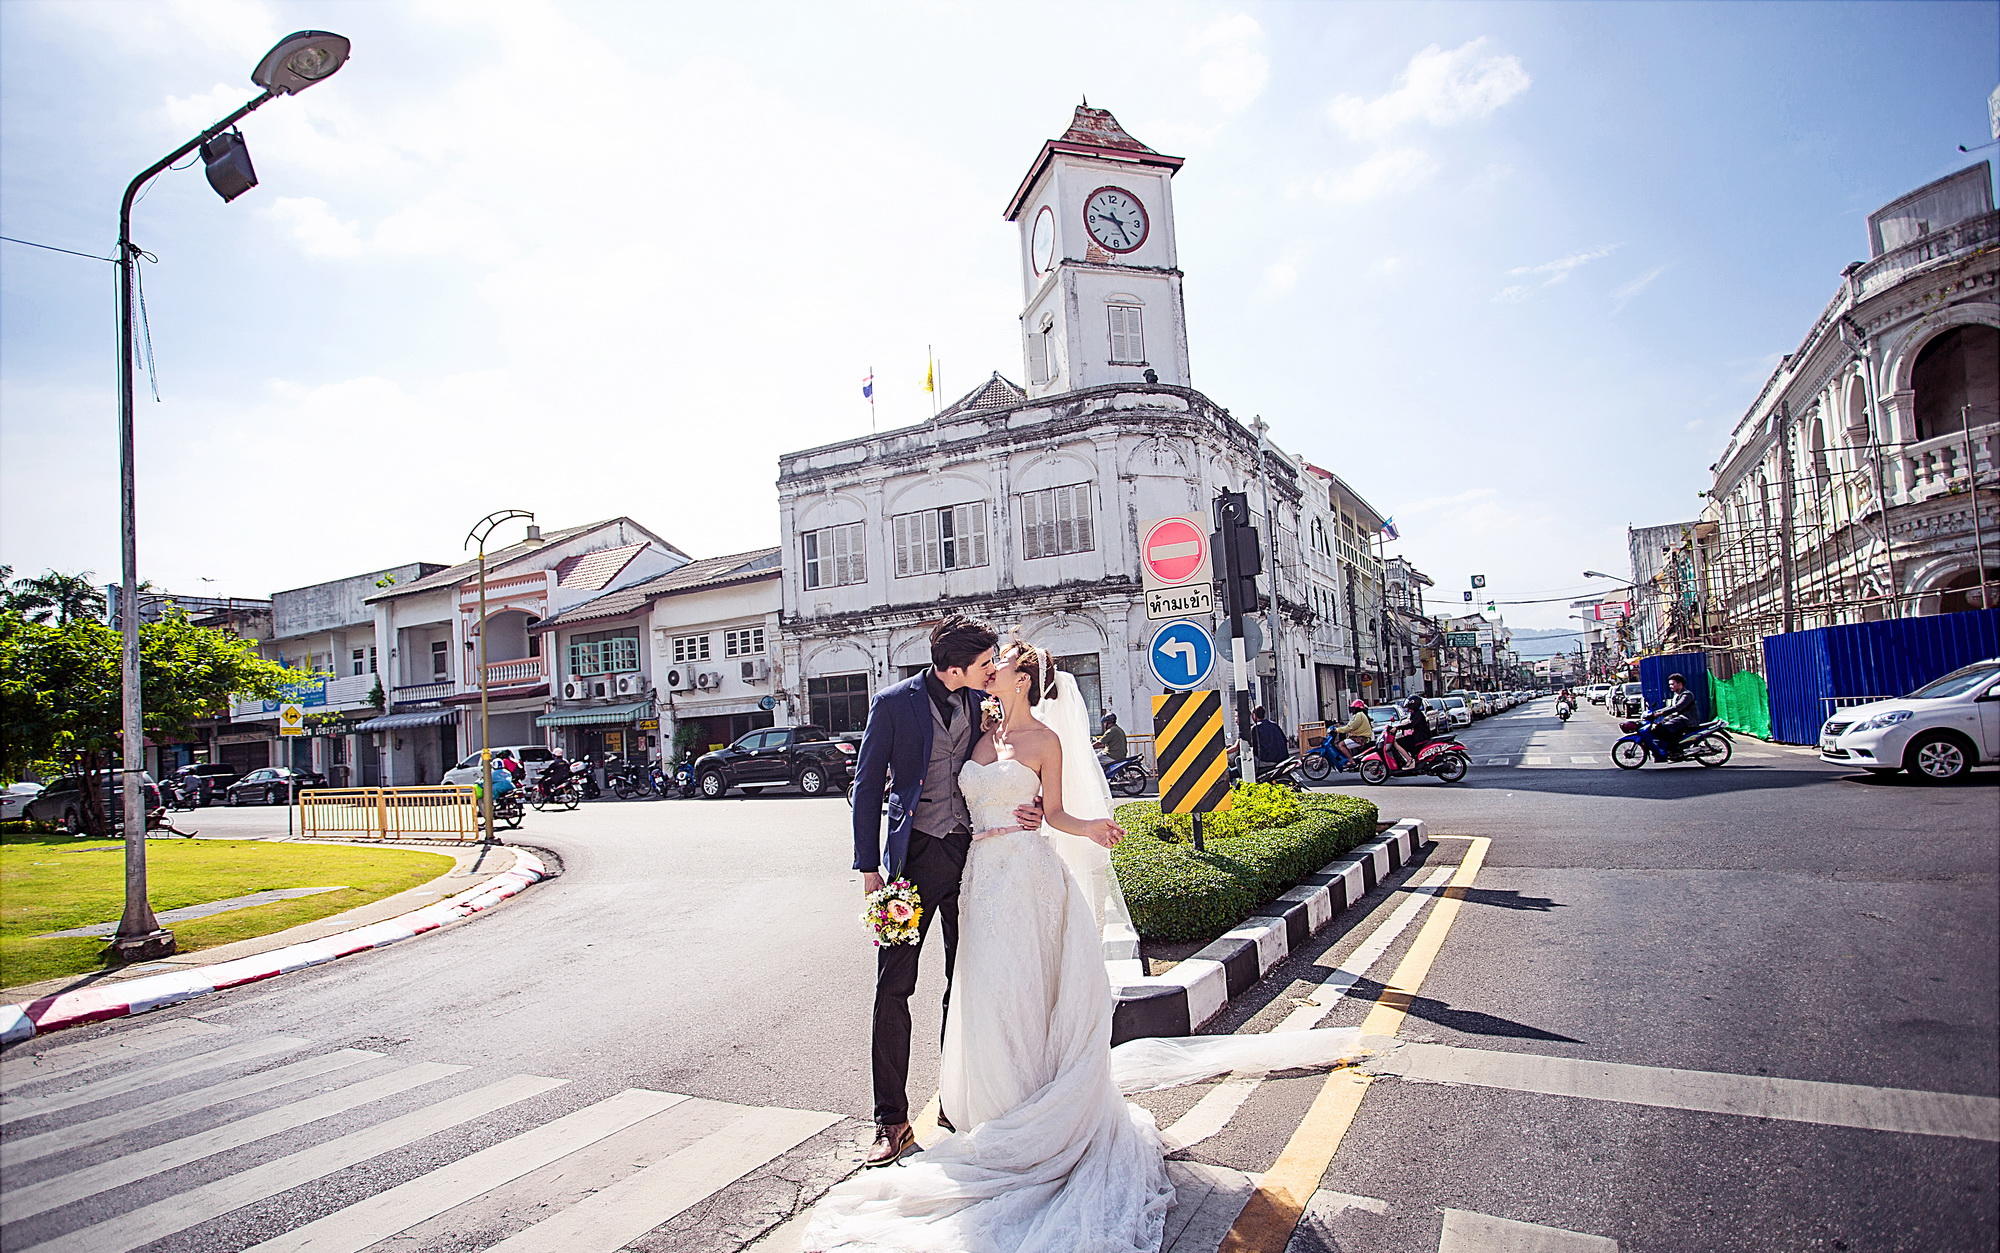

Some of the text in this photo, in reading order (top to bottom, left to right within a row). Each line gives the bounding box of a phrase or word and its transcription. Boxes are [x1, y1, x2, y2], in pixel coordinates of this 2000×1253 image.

[1108, 195, 1117, 204] 12
[1089, 215, 1096, 223] 9
[1134, 220, 1140, 228] 3
[1113, 240, 1120, 248] 6
[1150, 589, 1209, 613] ห้ามเข้า
